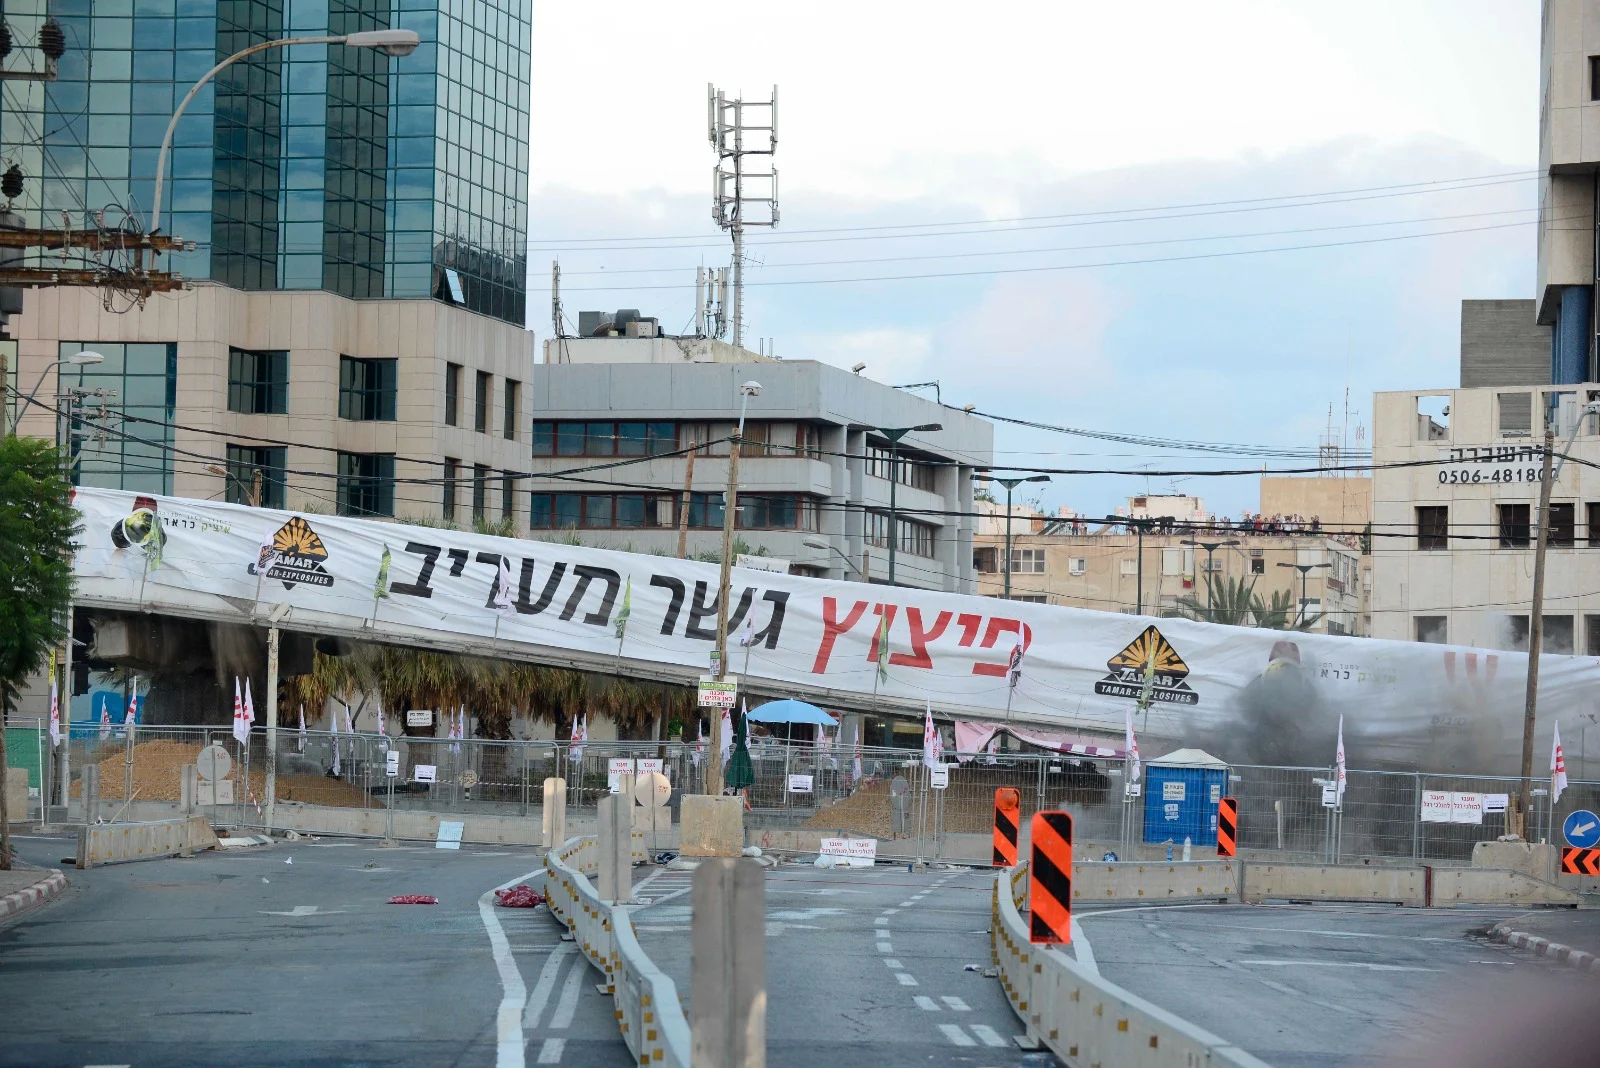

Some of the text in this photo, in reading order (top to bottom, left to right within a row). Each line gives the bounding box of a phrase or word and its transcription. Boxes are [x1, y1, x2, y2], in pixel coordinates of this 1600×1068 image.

[268, 568, 329, 585] AR-EXPLOSIVES
[389, 541, 1033, 678] פיצוץ גשר מעריב
[1101, 684, 1192, 703] TAMAR-EPLOSIVES
